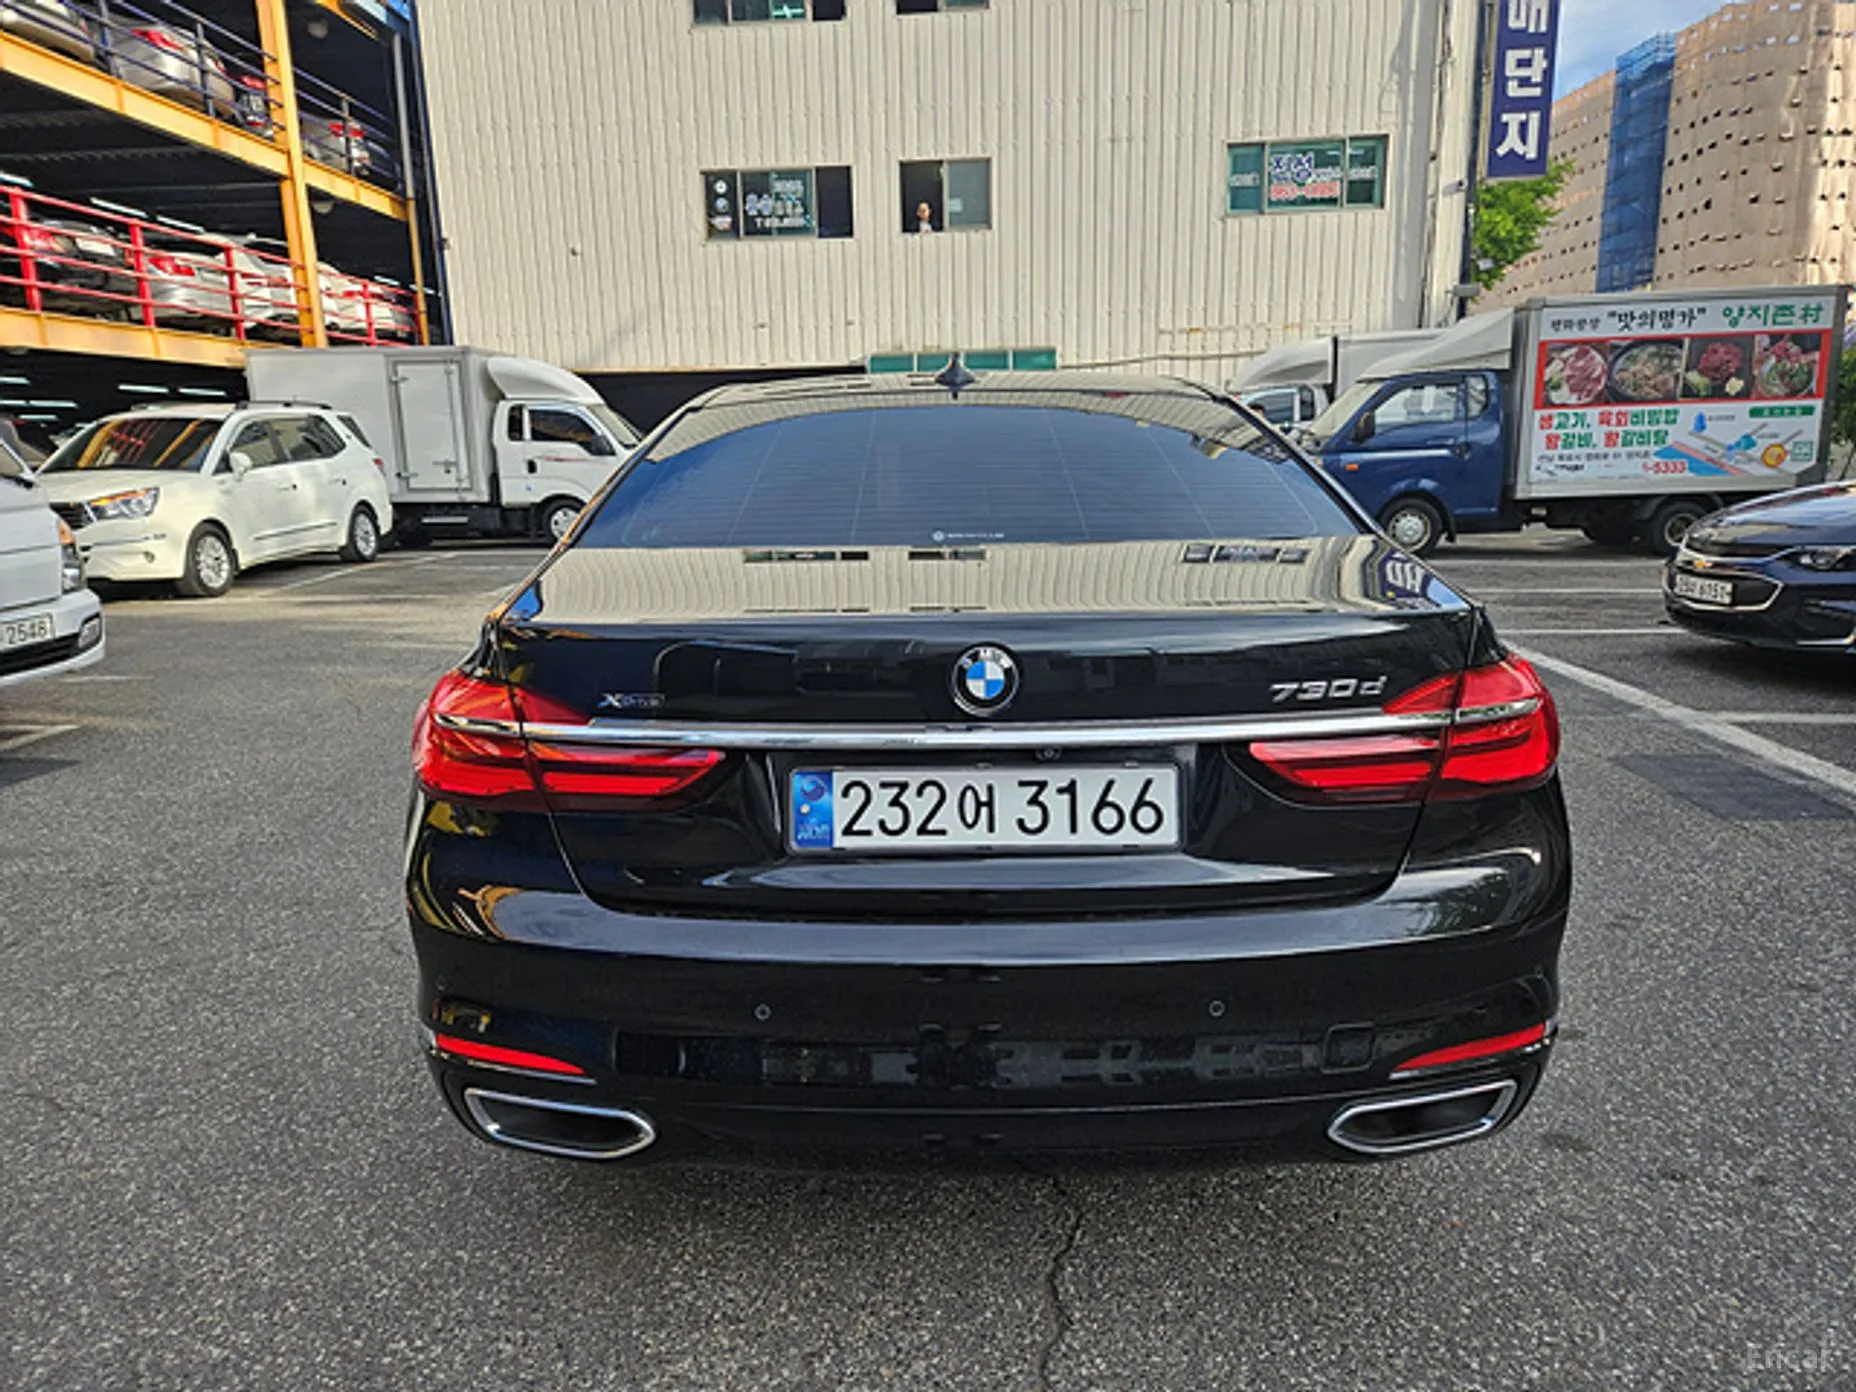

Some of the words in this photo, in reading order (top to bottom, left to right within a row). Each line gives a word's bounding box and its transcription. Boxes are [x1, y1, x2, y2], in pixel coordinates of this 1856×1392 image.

[1269, 675, 1388, 702] 730d
[840, 779, 995, 836] 232어
[1015, 778, 1164, 835] 3166
